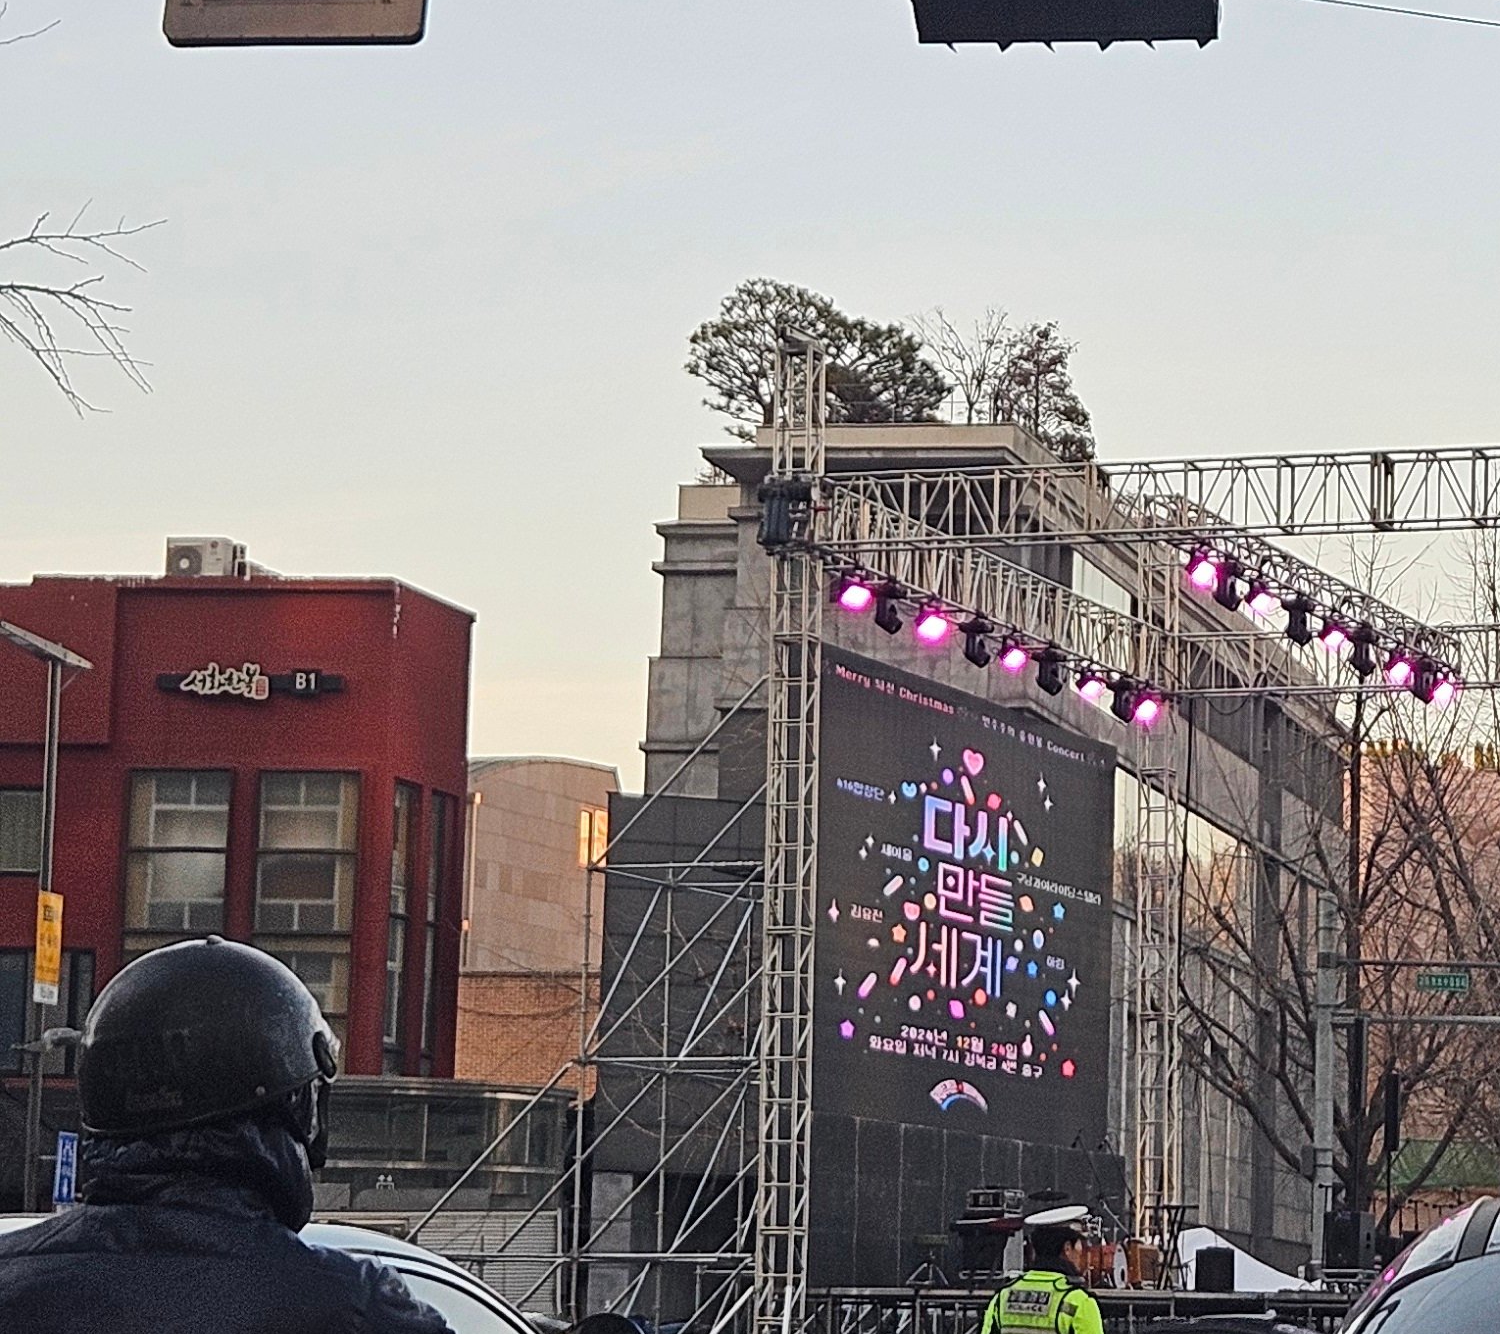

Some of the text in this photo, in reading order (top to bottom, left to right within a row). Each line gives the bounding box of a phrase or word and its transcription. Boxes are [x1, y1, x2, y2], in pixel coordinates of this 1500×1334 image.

[295, 672, 316, 690] B1
[835, 664, 871, 688] Merry
[899, 687, 954, 715] Christmas
[1046, 739, 1085, 762] Concert
[924, 795, 1008, 871] 다시
[938, 861, 1014, 931] 만들
[910, 921, 1001, 997] 세계
[869, 1034, 907, 1055] 화요일
[912, 1042, 937, 1060] 저녁
[942, 1048, 960, 1064] 7시
[900, 1025, 1018, 1060] 2024년 12월 24일
